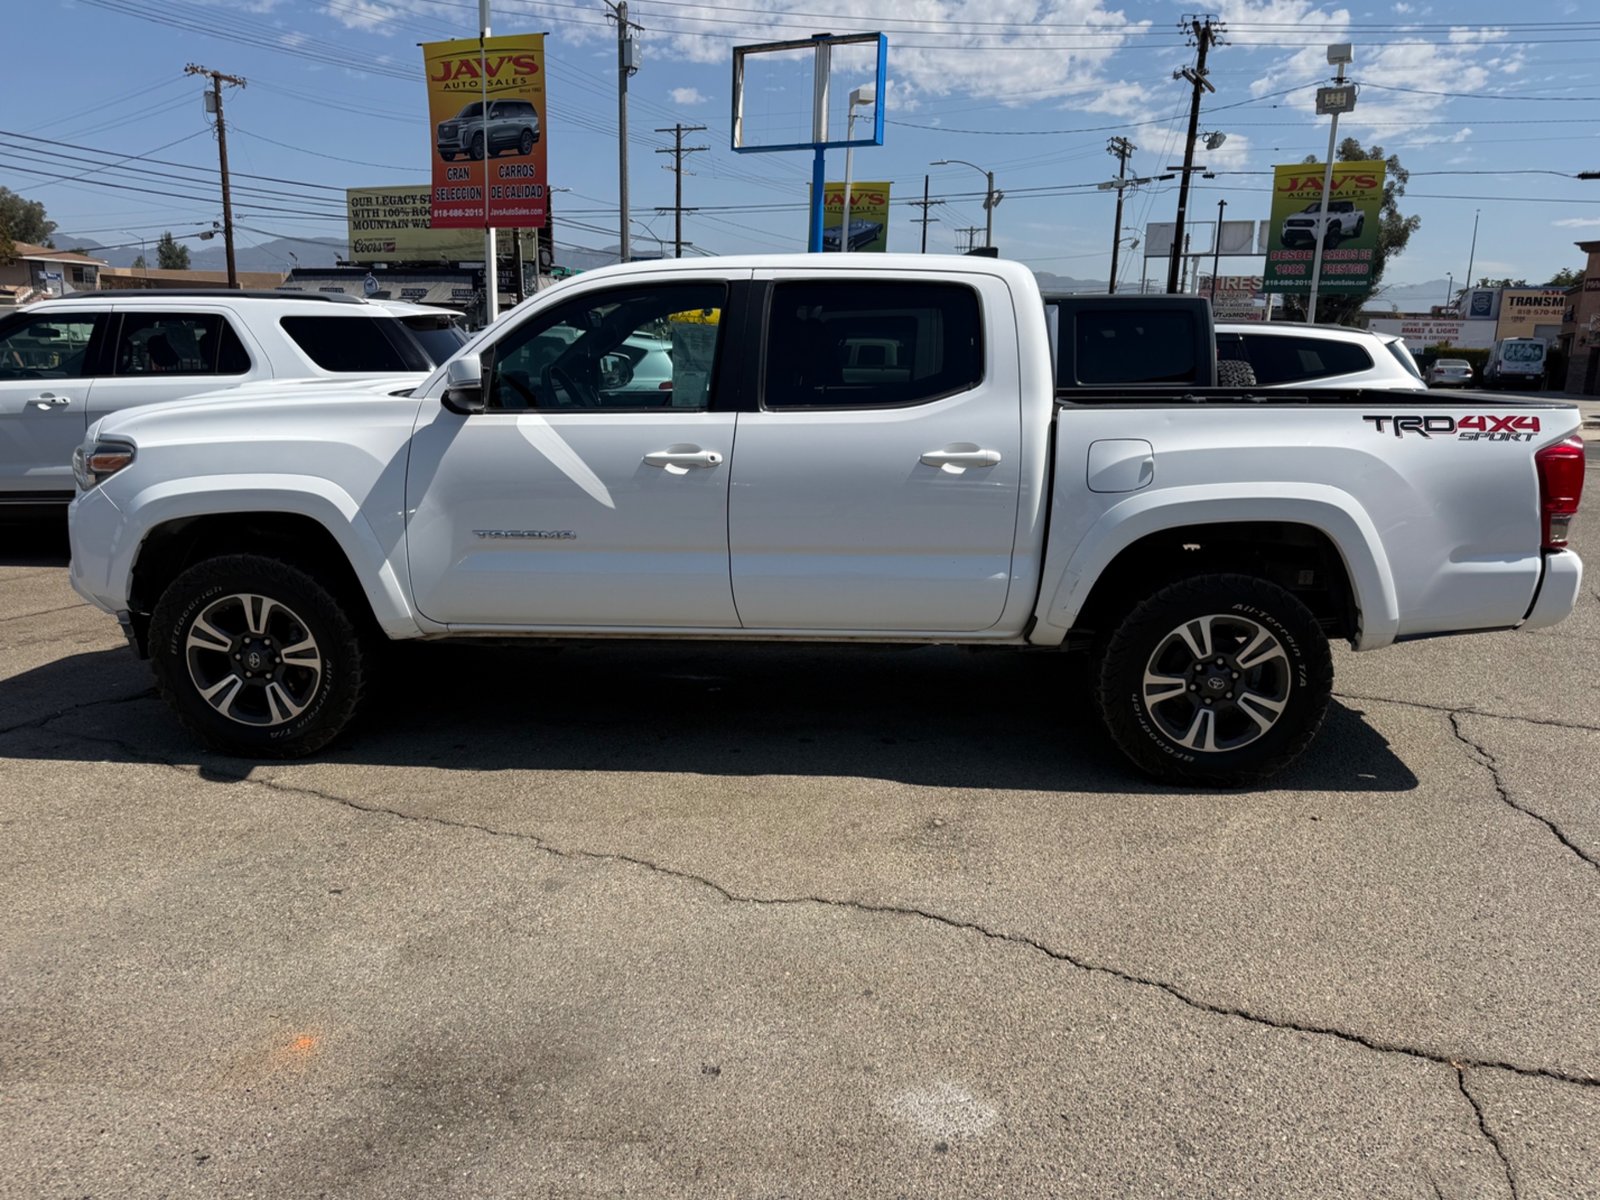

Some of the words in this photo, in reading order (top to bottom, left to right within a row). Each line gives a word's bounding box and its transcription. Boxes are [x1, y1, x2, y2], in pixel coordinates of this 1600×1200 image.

[431, 55, 539, 81] JAV'S
[443, 80, 478, 89] AUTO
[487, 77, 527, 86] SALES
[447, 167, 470, 180] GRAN
[499, 164, 535, 178] CARROS
[1278, 174, 1377, 192] JAV'S
[436, 187, 482, 200] SELECCION
[491, 186, 502, 198] DE
[504, 185, 543, 198] CALIDAD
[351, 196, 372, 207] OUR
[376, 194, 417, 205] LEGACY
[420, 194, 432, 204] ST
[352, 208, 379, 218] WITH
[383, 207, 409, 217] 100%
[353, 219, 408, 230] MOUNTAIN
[353, 238, 382, 253] Coors
[1270, 250, 1313, 260] DESDE
[1323, 249, 1358, 260] CARROS
[1359, 249, 1372, 260] DE
[1275, 264, 1306, 274] 1982
[1322, 263, 1369, 274] PRESTIGIO
[1508, 296, 1564, 306] TRANSM
[1363, 415, 1457, 439] TRD
[1458, 432, 1538, 441] SPORT
[472, 529, 576, 539] TACOMA
[1231, 603, 1301, 656] All-Terrain
[1298, 663, 1307, 687] T/A
